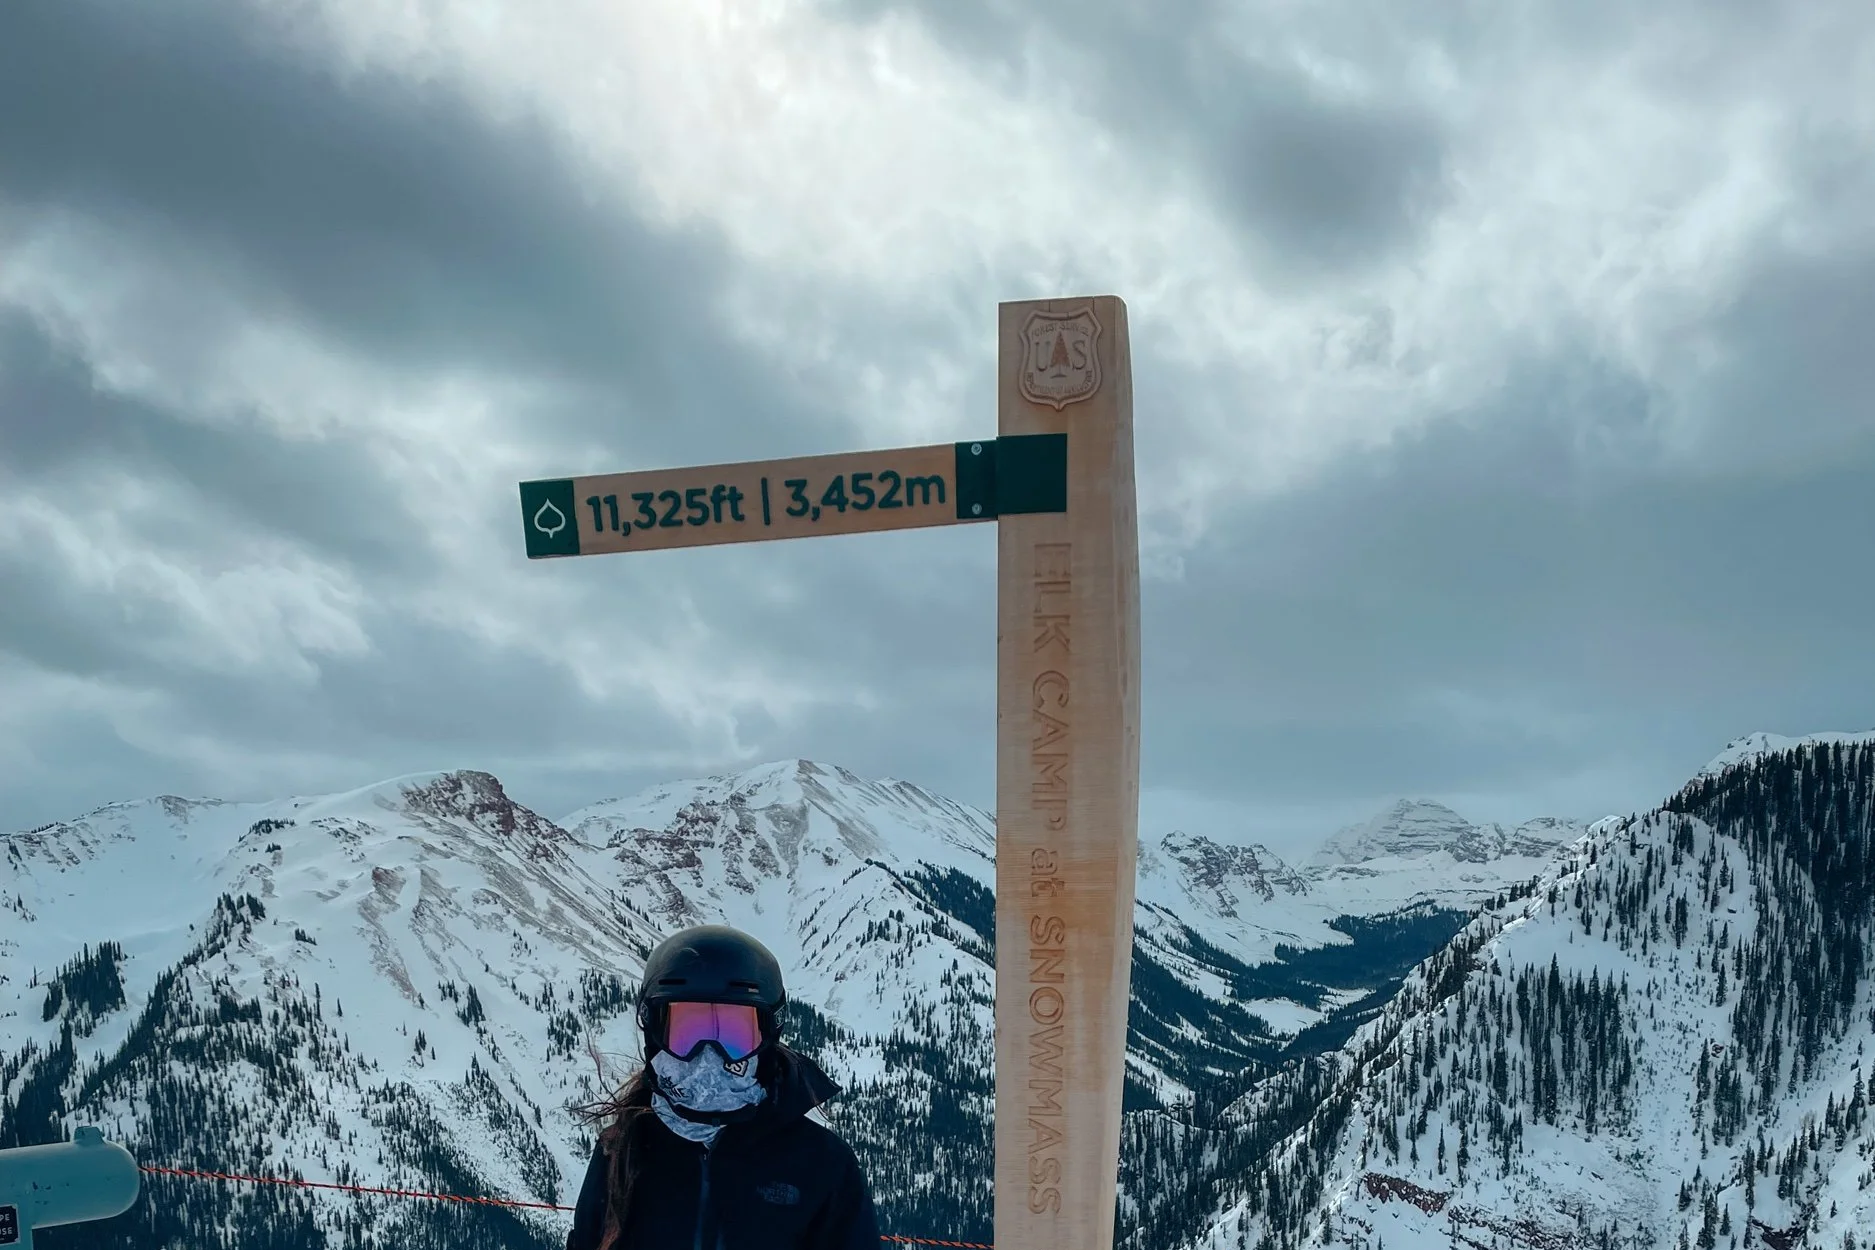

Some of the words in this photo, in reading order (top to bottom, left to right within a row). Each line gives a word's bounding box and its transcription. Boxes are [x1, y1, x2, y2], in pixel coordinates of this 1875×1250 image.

[1035, 341, 1051, 372] U
[1072, 340, 1087, 370] S
[586, 484, 745, 538] 11,325ft
[784, 469, 946, 522] 3,452m
[1032, 541, 1072, 654] ELK
[1031, 669, 1071, 833] CAMP
[1030, 846, 1067, 899] at
[1027, 914, 1066, 1216] SNOWMASS
